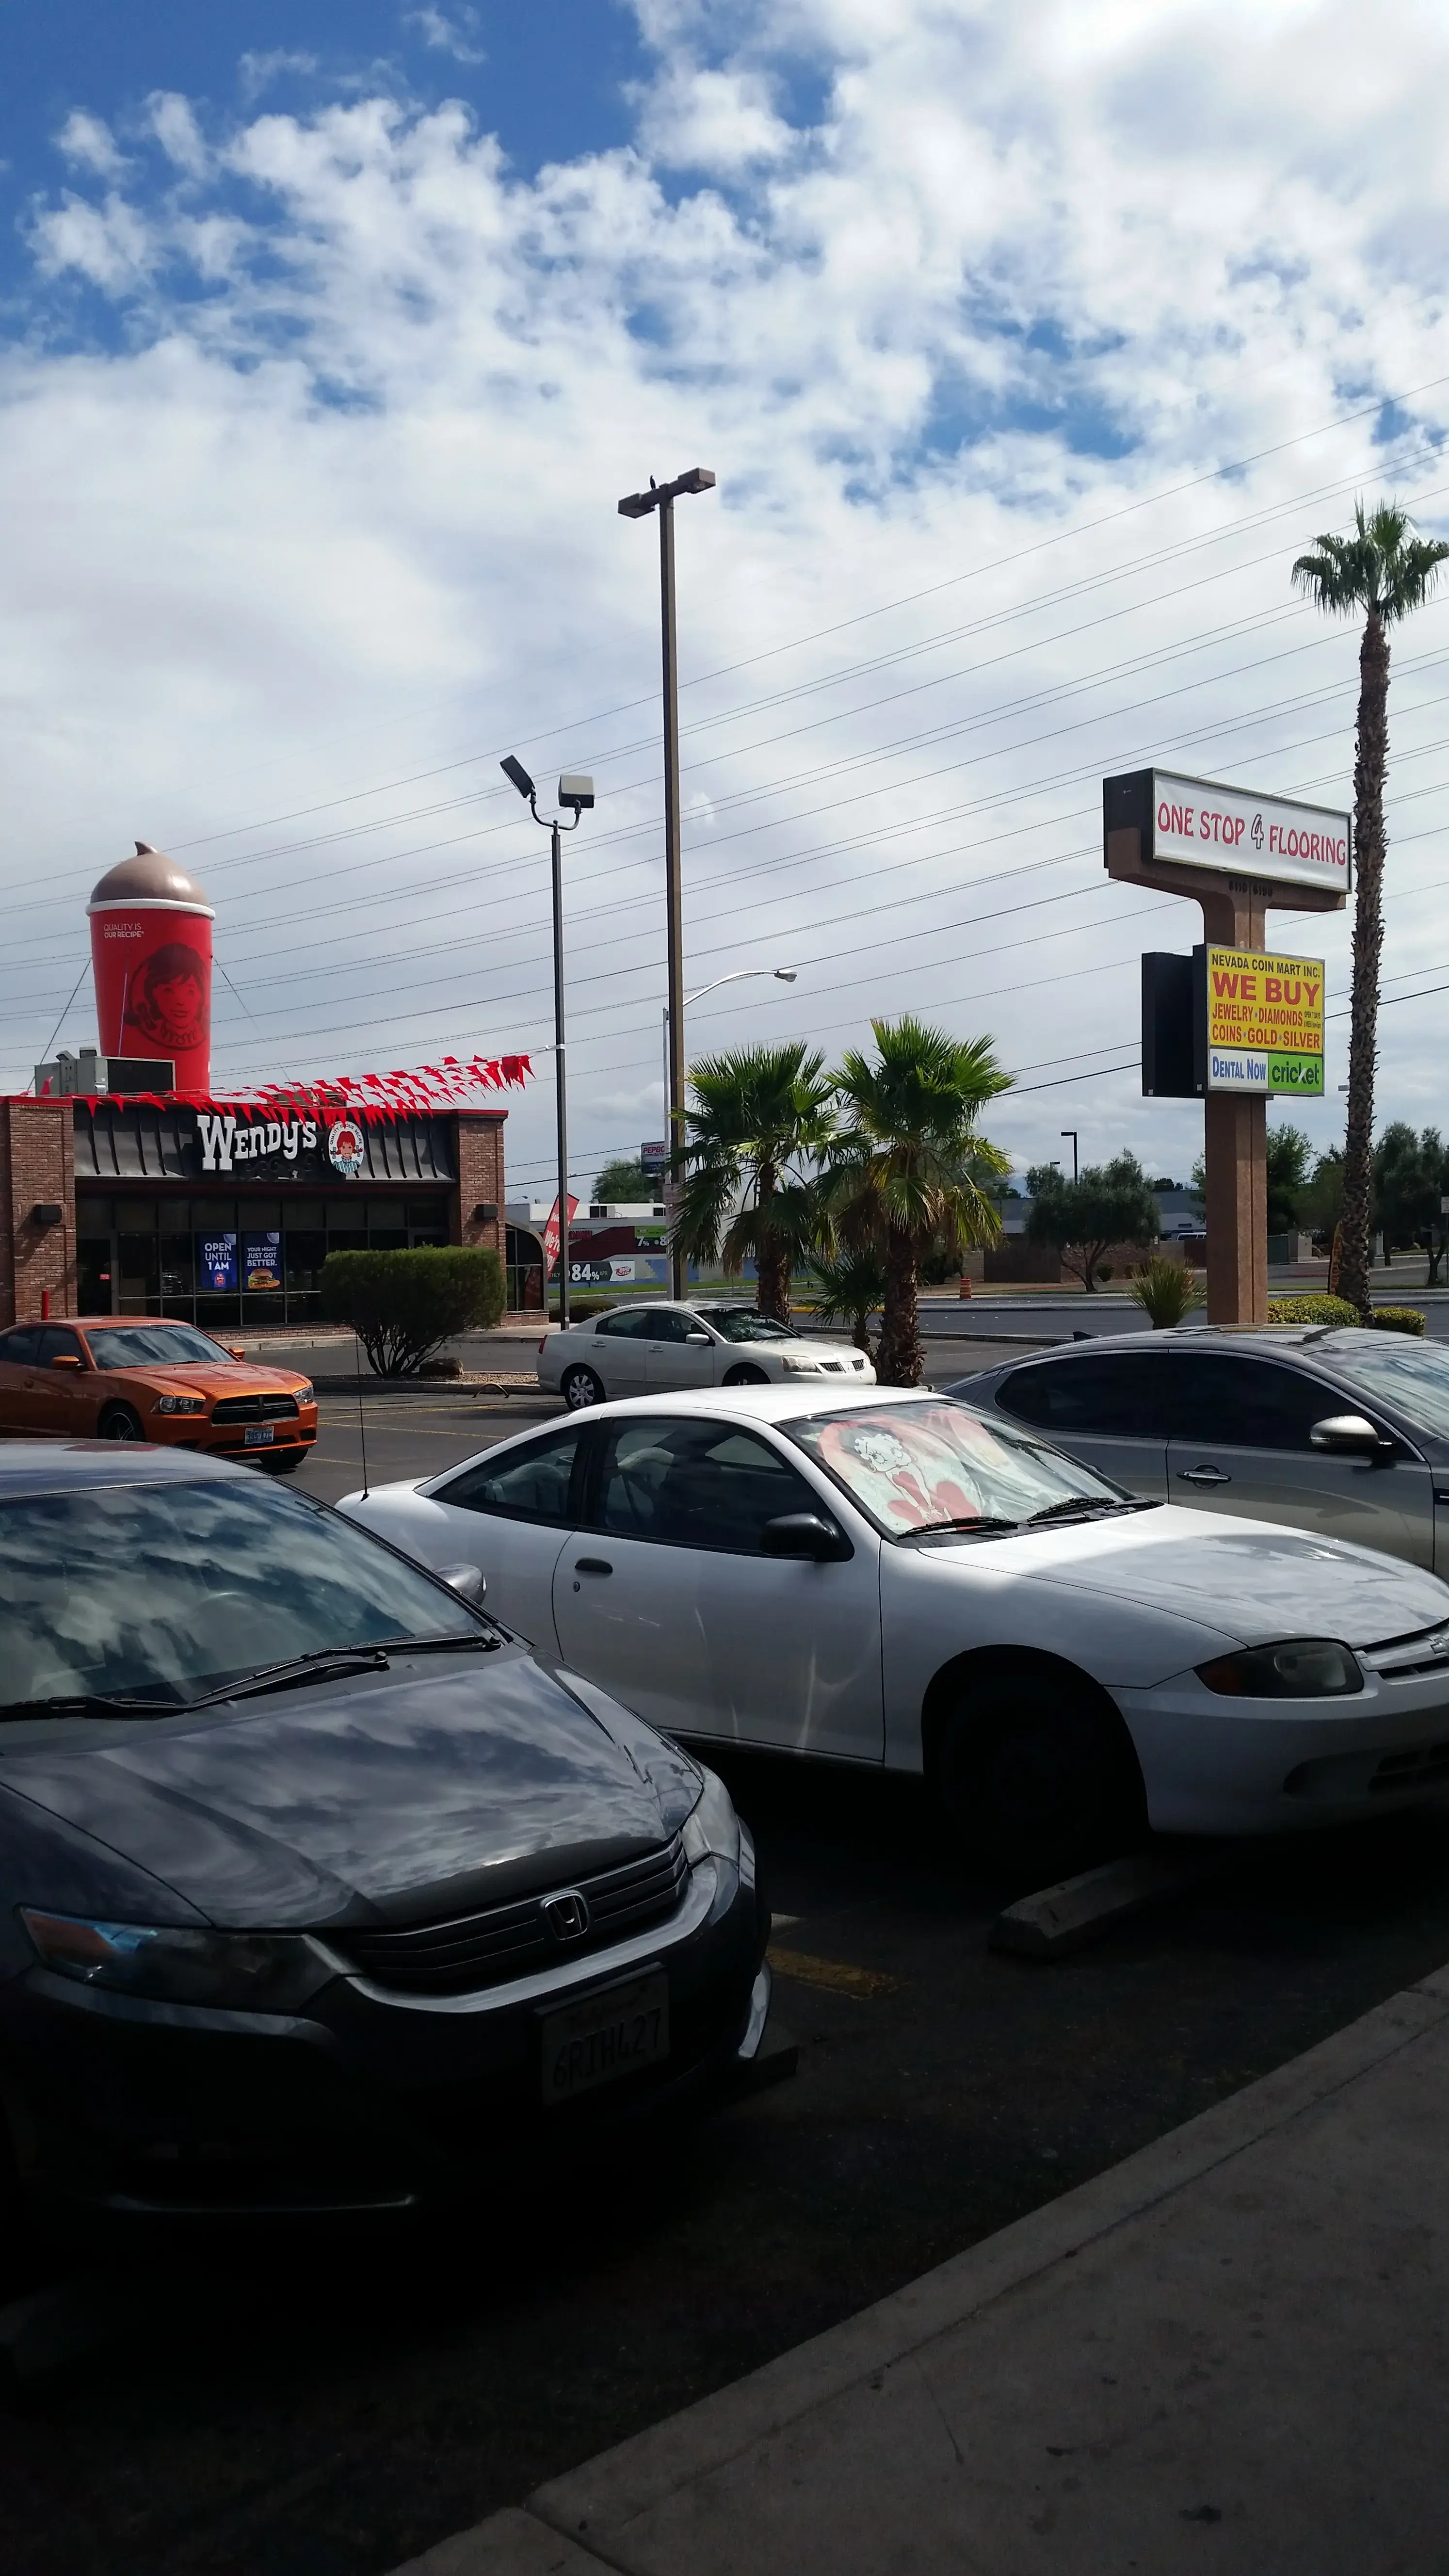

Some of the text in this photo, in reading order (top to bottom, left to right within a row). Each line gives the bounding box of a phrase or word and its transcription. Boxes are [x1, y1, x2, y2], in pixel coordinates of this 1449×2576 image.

[1158, 802, 1346, 866] ONE STOP 4 FLOORING
[1212, 953, 1320, 978] NEVADA COIN MART INC.
[1212, 971, 1320, 1007] WE BUY
[1212, 1003, 1303, 1027] JEWELRY DIAMONDS
[1212, 1024, 1320, 1048] COINS GOLD SILVER
[1272, 1061, 1320, 1085] cricket
[330, 1127, 339, 1145] QUALITY
[354, 1129, 363, 1144] RECIPE
[205, 1243, 232, 1252] OPEN
[205, 1252, 232, 1261] UNTIL
[208, 1262, 229, 1270] 1 AM
[571, 1264, 600, 1281] 84%
